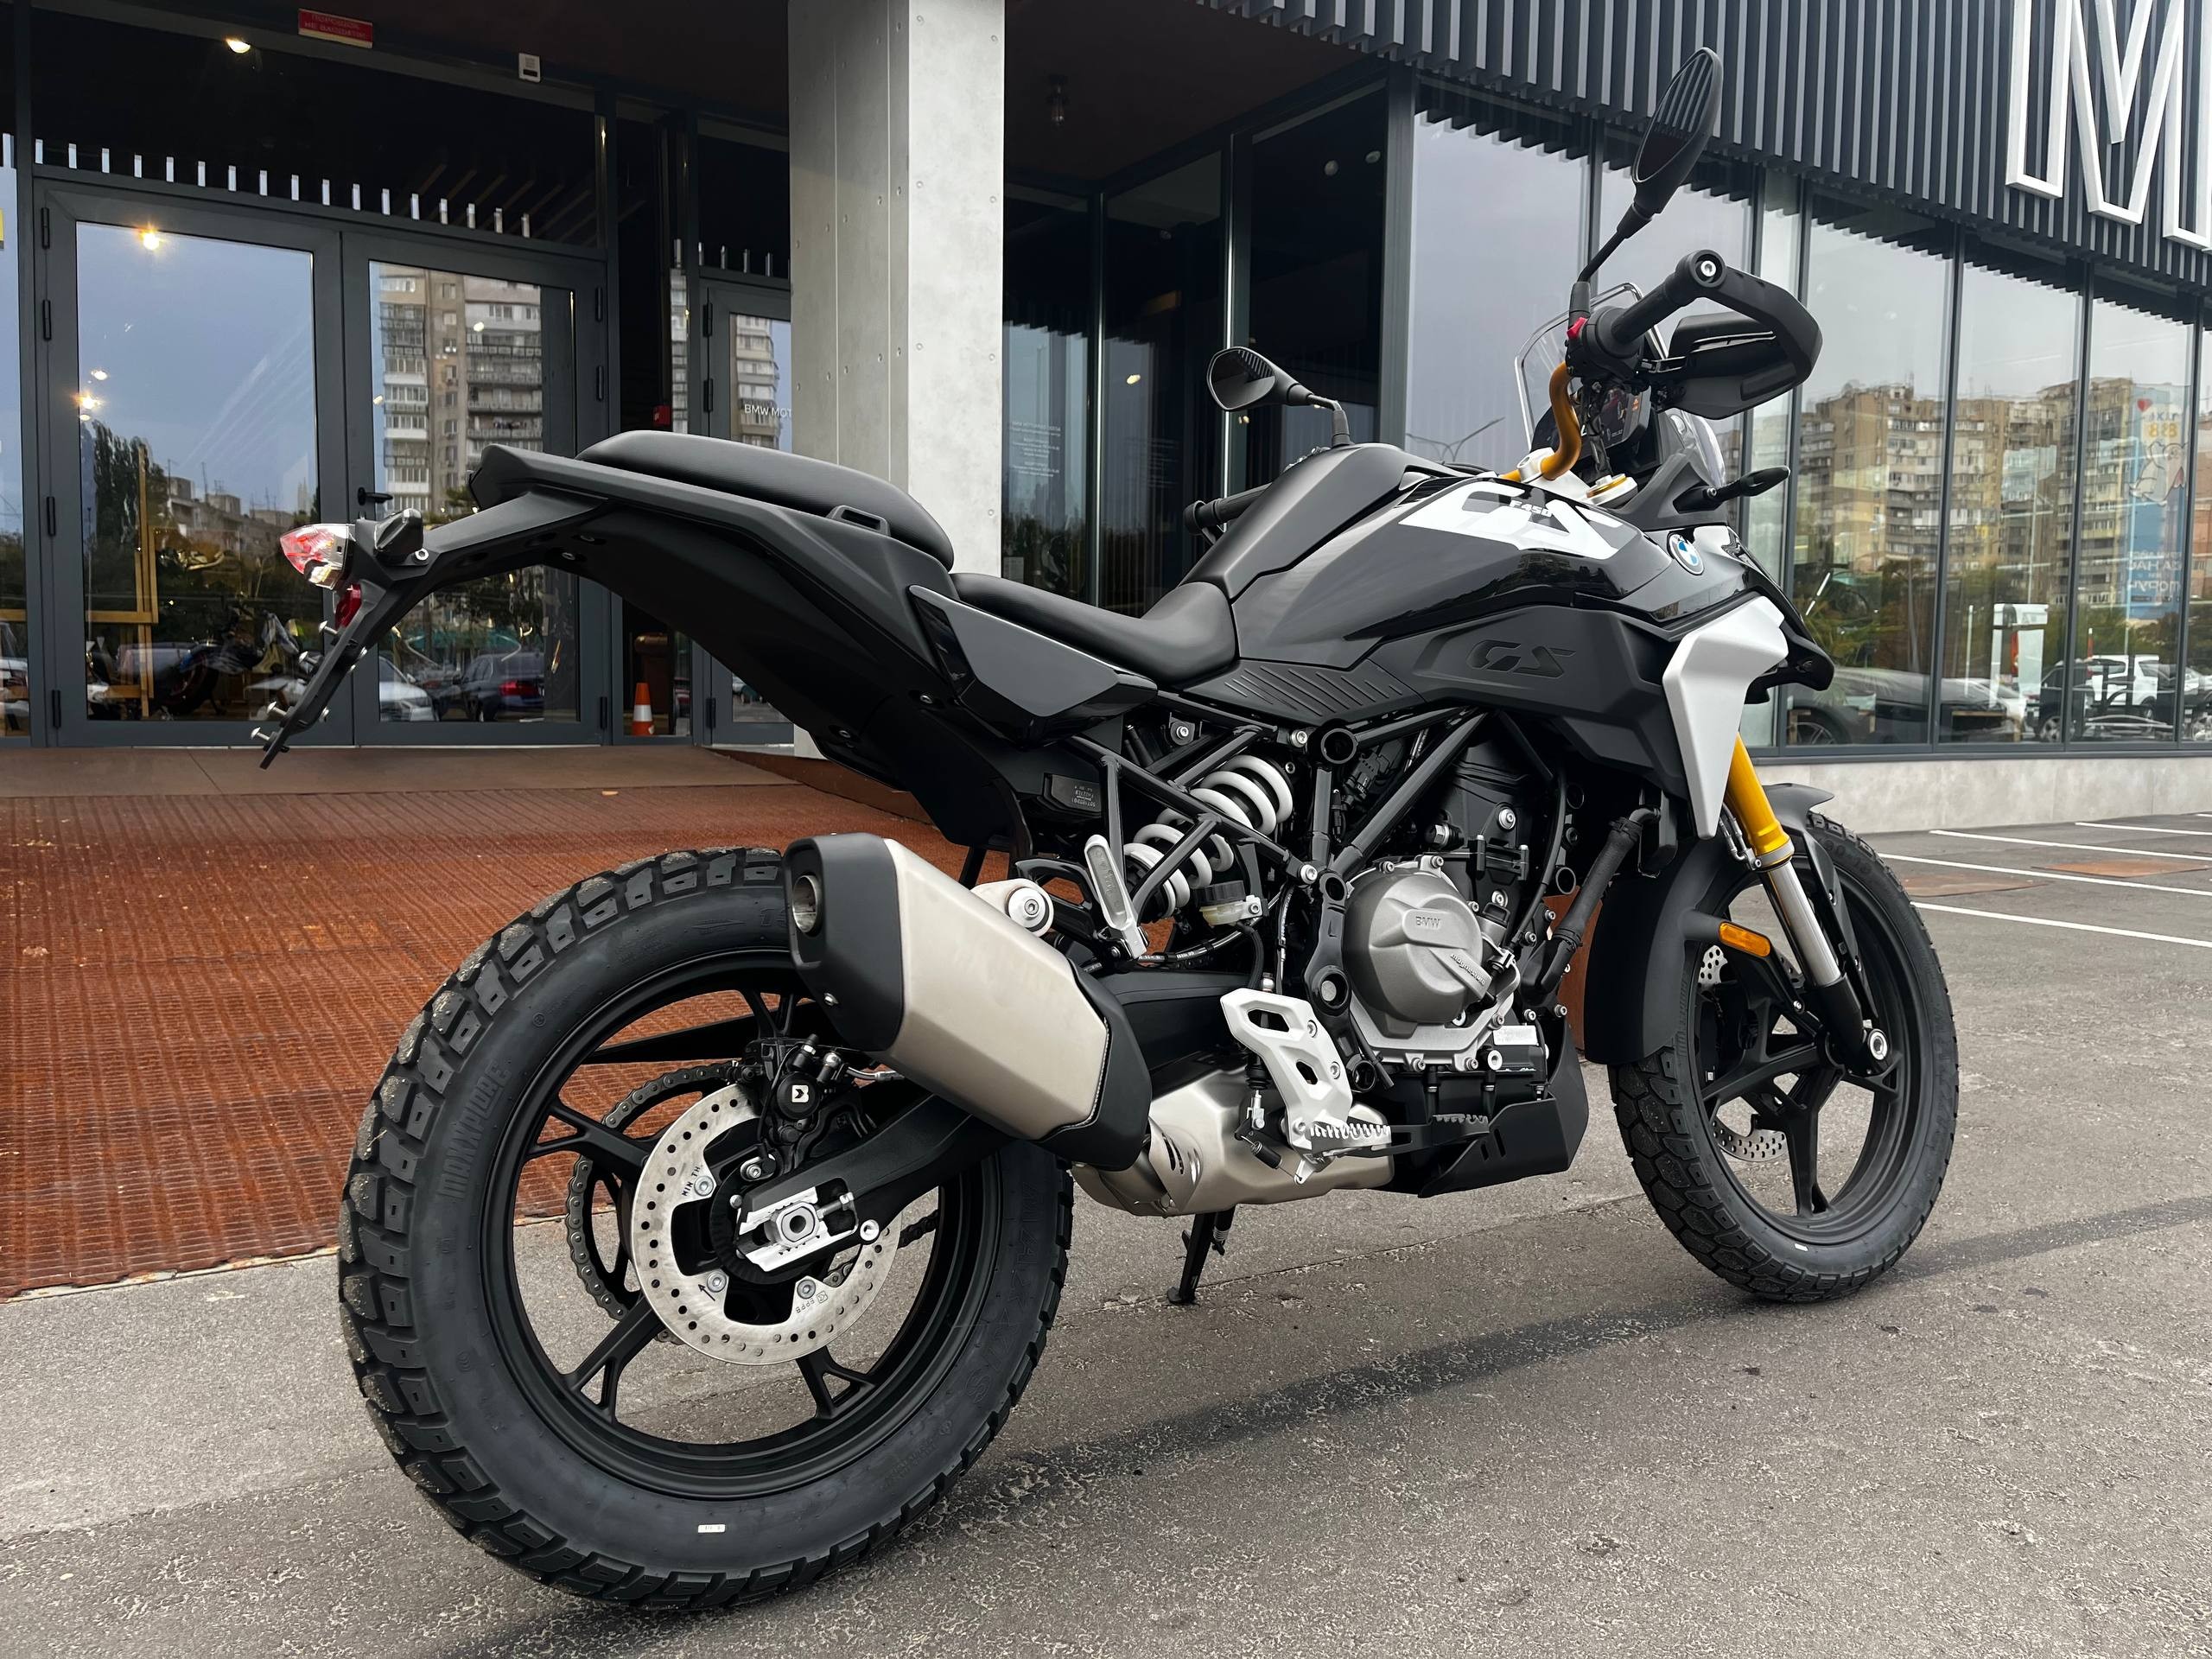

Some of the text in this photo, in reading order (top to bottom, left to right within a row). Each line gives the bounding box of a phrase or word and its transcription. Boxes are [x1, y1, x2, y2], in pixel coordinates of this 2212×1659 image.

[2005, 0, 2212, 252] M
[744, 404, 769, 416] BMW
[1466, 639, 1576, 679] GS
[1415, 916, 1441, 929] BMW
[681, 1181, 694, 1197] MIN
